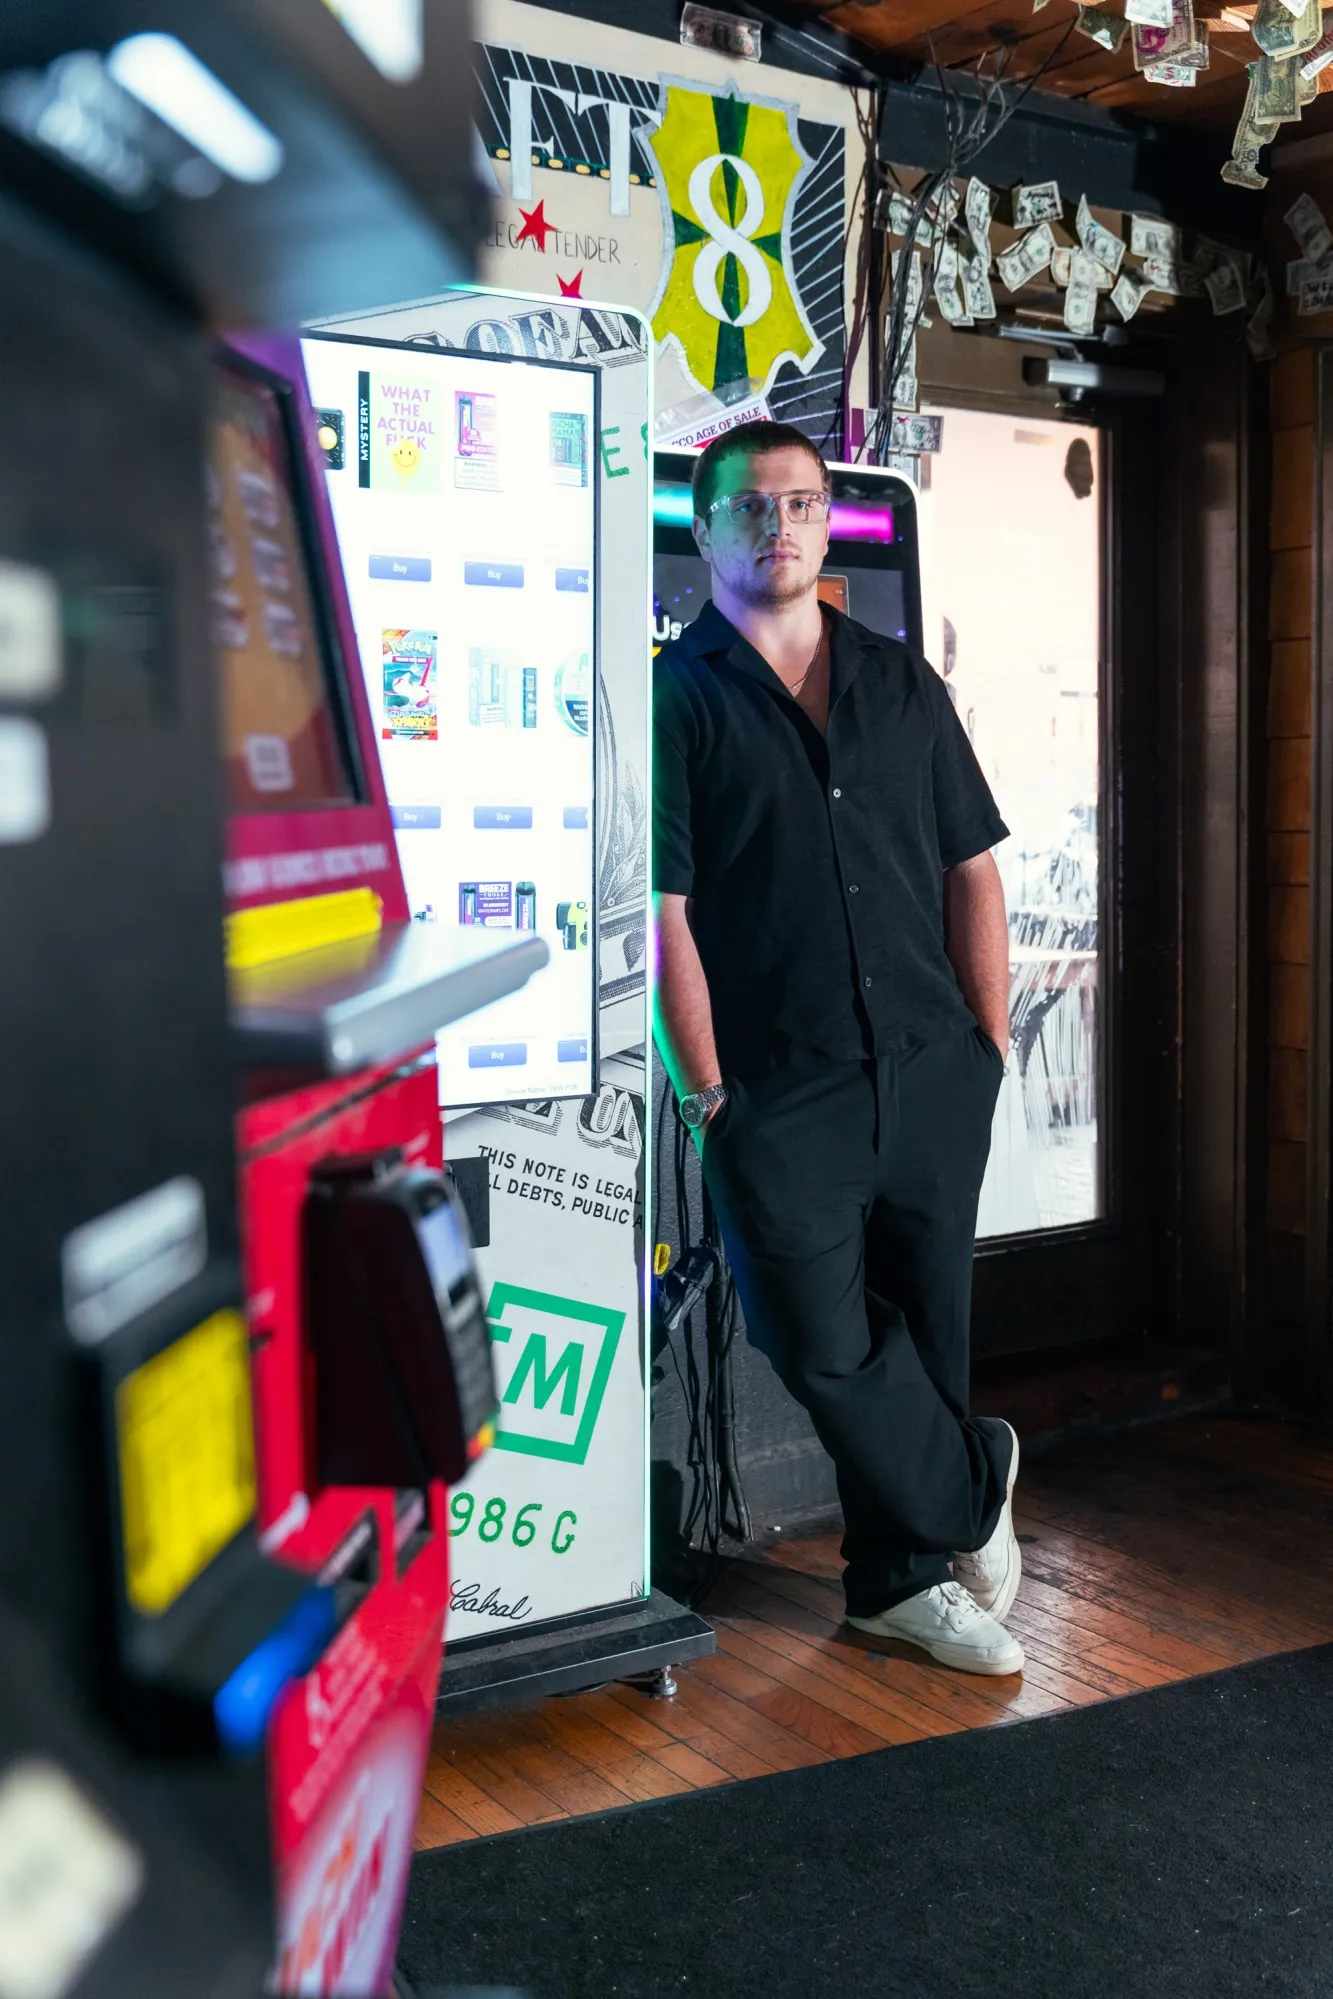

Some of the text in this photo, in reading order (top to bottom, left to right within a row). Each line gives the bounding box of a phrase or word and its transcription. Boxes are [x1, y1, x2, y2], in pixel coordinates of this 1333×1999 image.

[554, 229, 621, 264] TENDER
[688, 152, 772, 326] 8
[381, 384, 431, 403] WHAT
[392, 402, 421, 417] THE
[360, 398, 369, 461] MYSTERY
[377, 416, 435, 435] ACTUAL
[696, 425, 718, 441] AGE
[718, 418, 732, 431] OF
[734, 406, 762, 427] SALE
[600, 425, 629, 479] E
[393, 563, 407, 574] Buy
[487, 570, 501, 580] Buy
[653, 614, 692, 641] Us
[403, 812, 418, 822] Buy
[496, 812, 511, 822] Buy
[479, 884, 509, 893] BREEZE
[491, 1051, 505, 1061] Buy
[478, 1144, 642, 1205] THIS NOTE IS LEGAL
[507, 1178, 566, 1211] DEBTS,
[571, 1196, 630, 1225] PUBLIC
